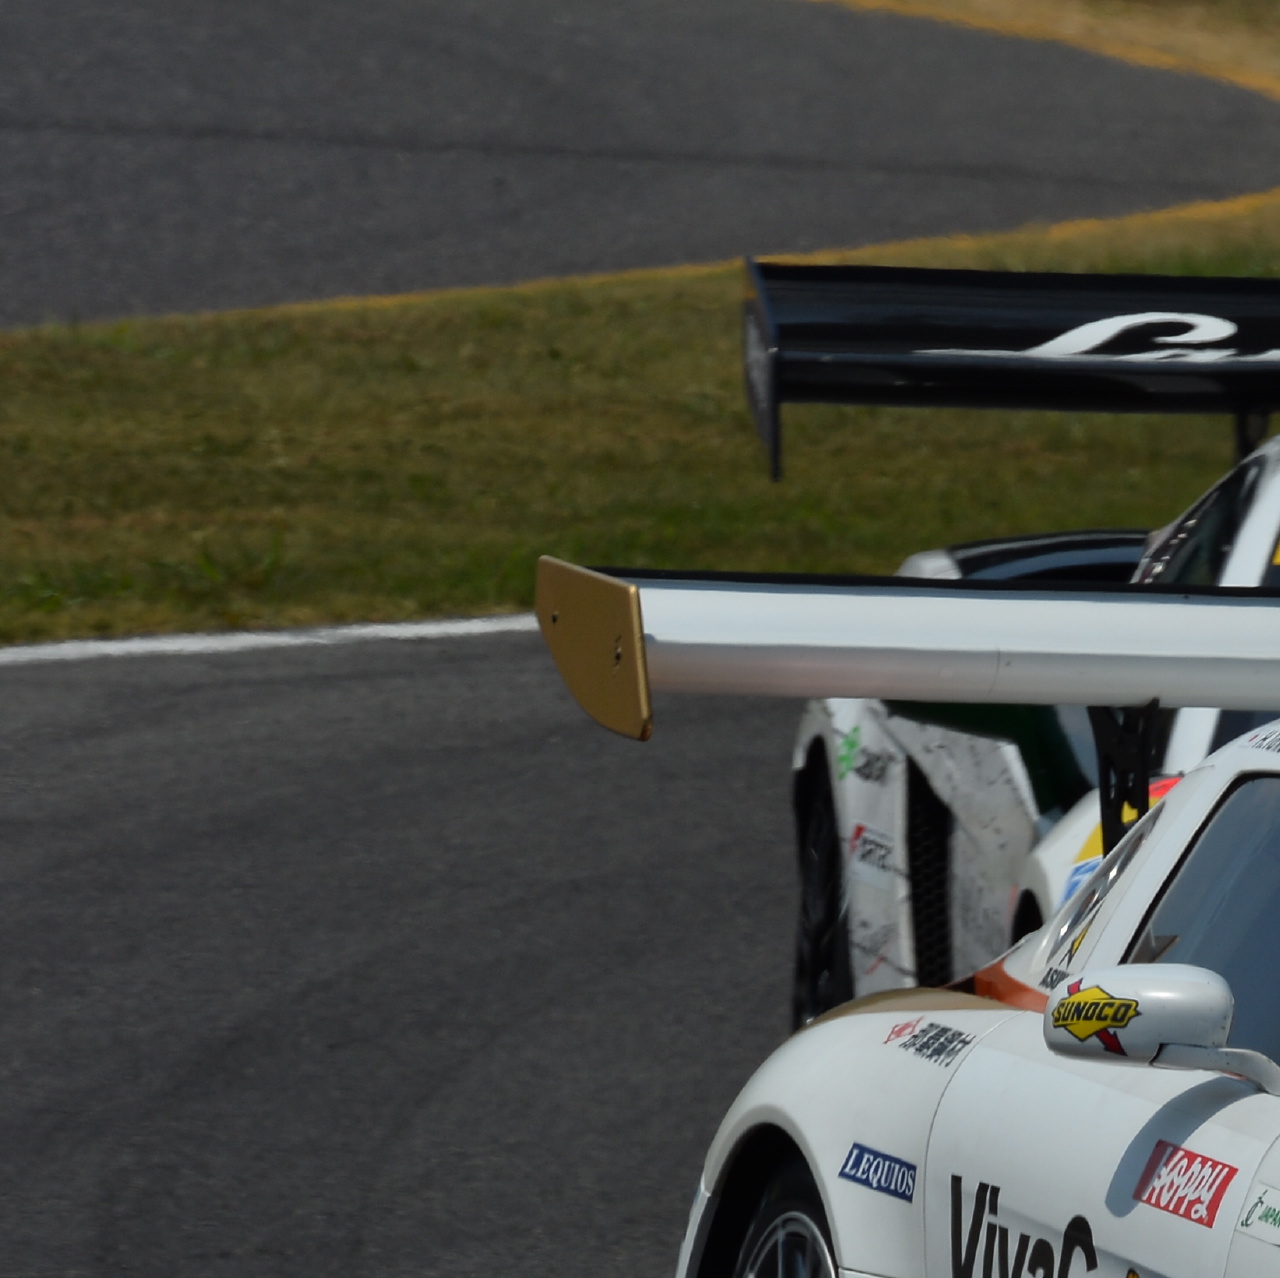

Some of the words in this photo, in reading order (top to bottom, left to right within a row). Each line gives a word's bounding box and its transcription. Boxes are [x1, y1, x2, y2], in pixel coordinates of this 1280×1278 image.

[1053, 999, 1131, 1024] SUNOCO
[843, 1146, 916, 1198] LEQUIOS
[1141, 1146, 1230, 1223] Hoppy
